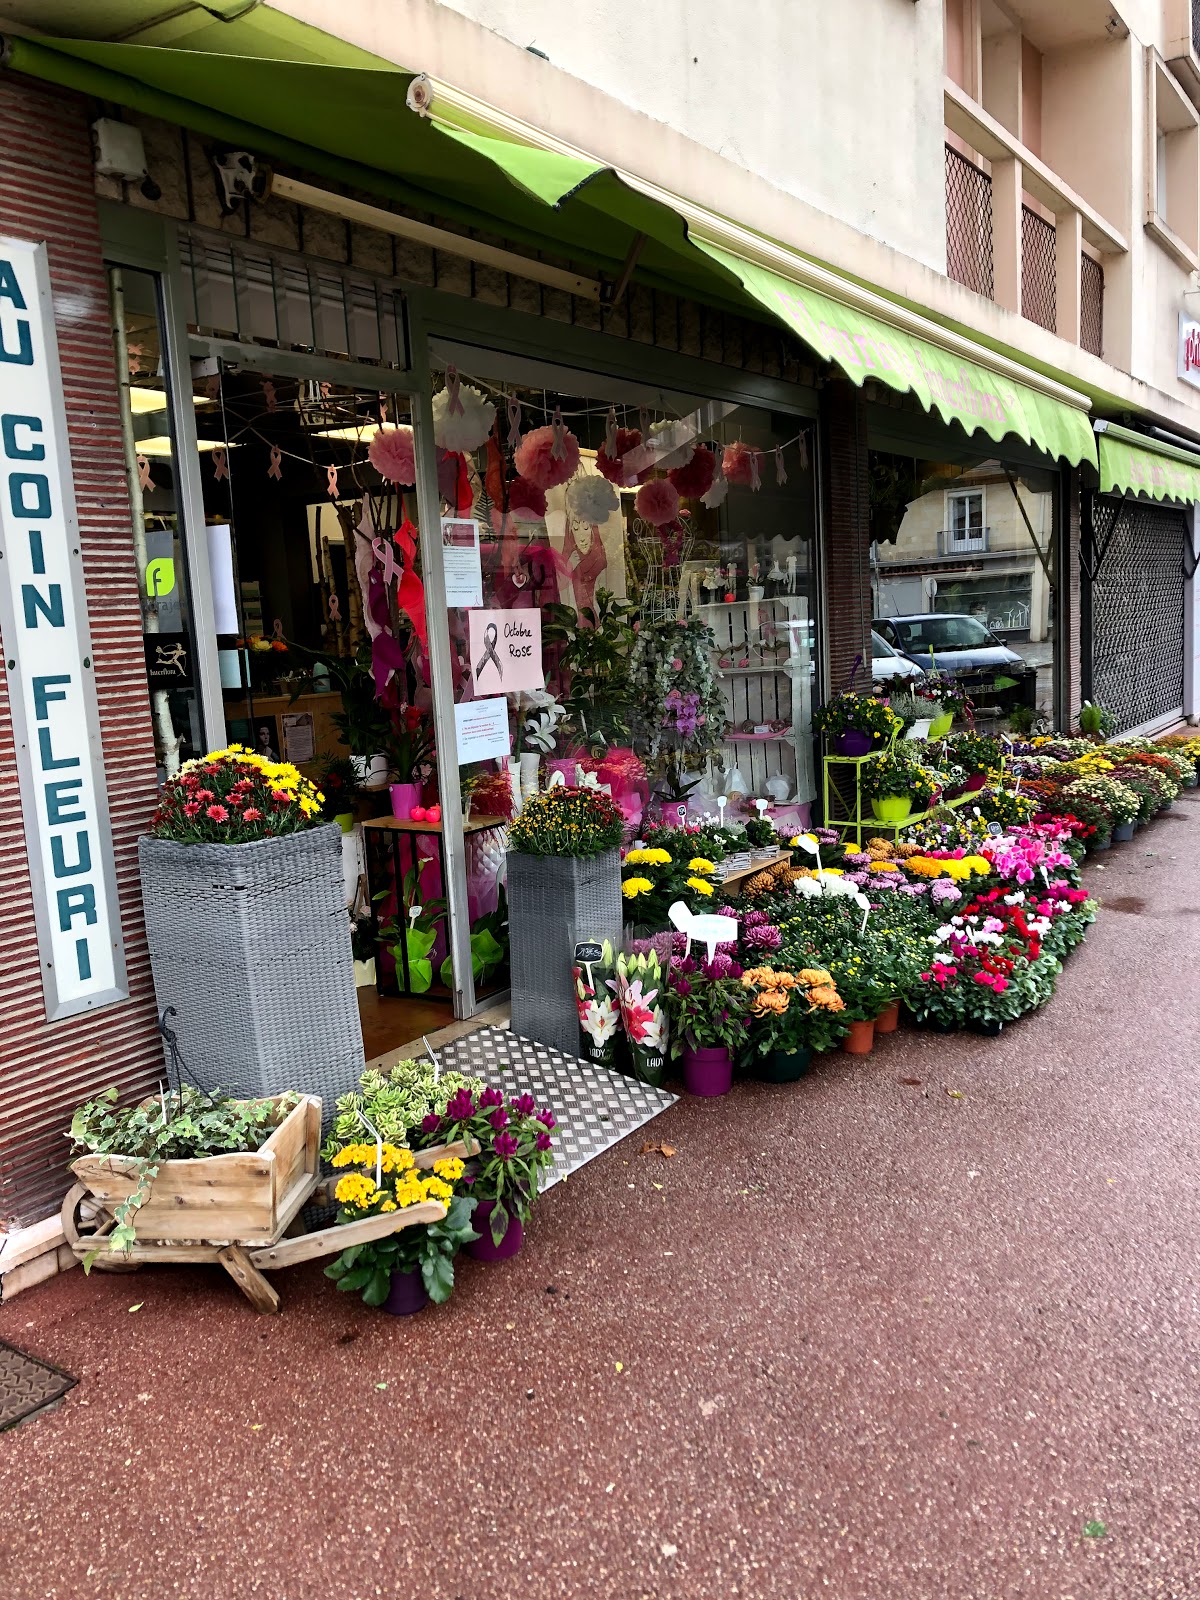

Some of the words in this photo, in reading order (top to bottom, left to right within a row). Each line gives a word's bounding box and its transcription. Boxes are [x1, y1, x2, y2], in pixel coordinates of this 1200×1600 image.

[0, 260, 34, 365] AU
[1, 413, 65, 628] COIN
[504, 621, 532, 638] Octobre
[32, 674, 98, 981] FLEURI
[646, 1056, 664, 1067] LADY
